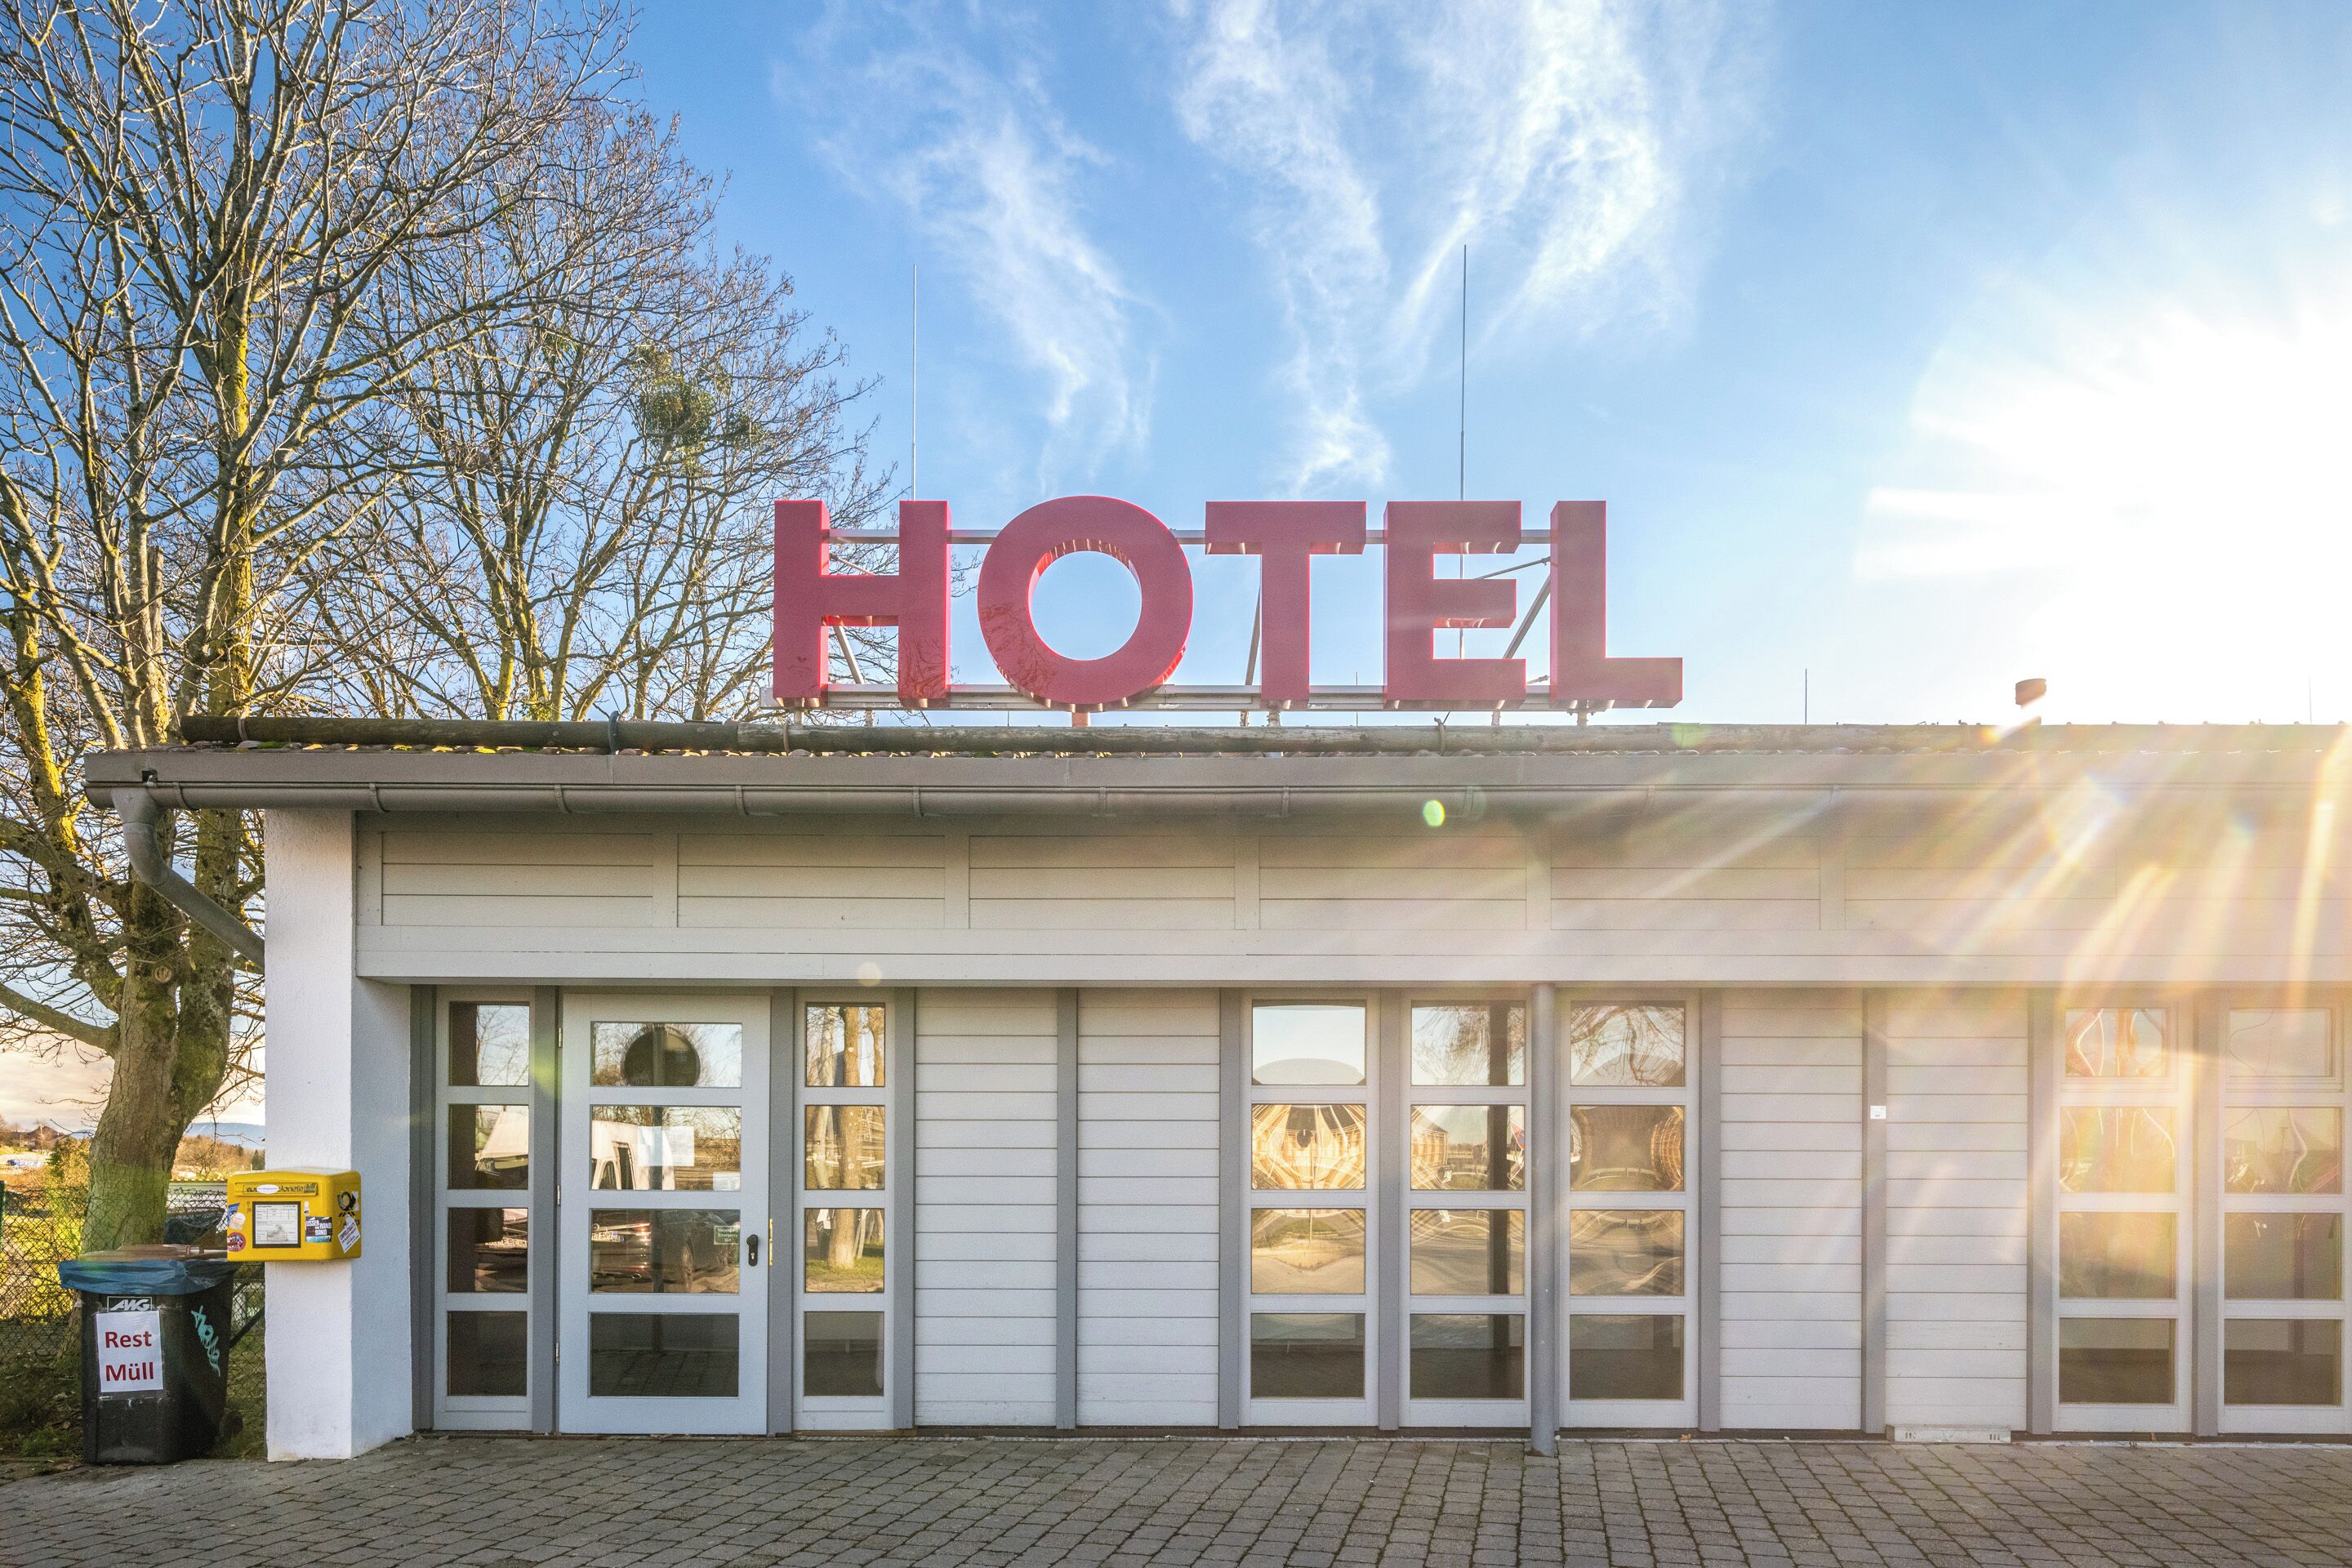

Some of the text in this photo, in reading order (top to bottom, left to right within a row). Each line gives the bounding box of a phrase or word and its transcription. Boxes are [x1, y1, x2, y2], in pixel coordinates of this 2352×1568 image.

[774, 496, 1683, 708] HOTEL
[109, 1298, 150, 1312] AWG
[105, 1331, 152, 1348] Rest
[105, 1361, 154, 1382] Müll
